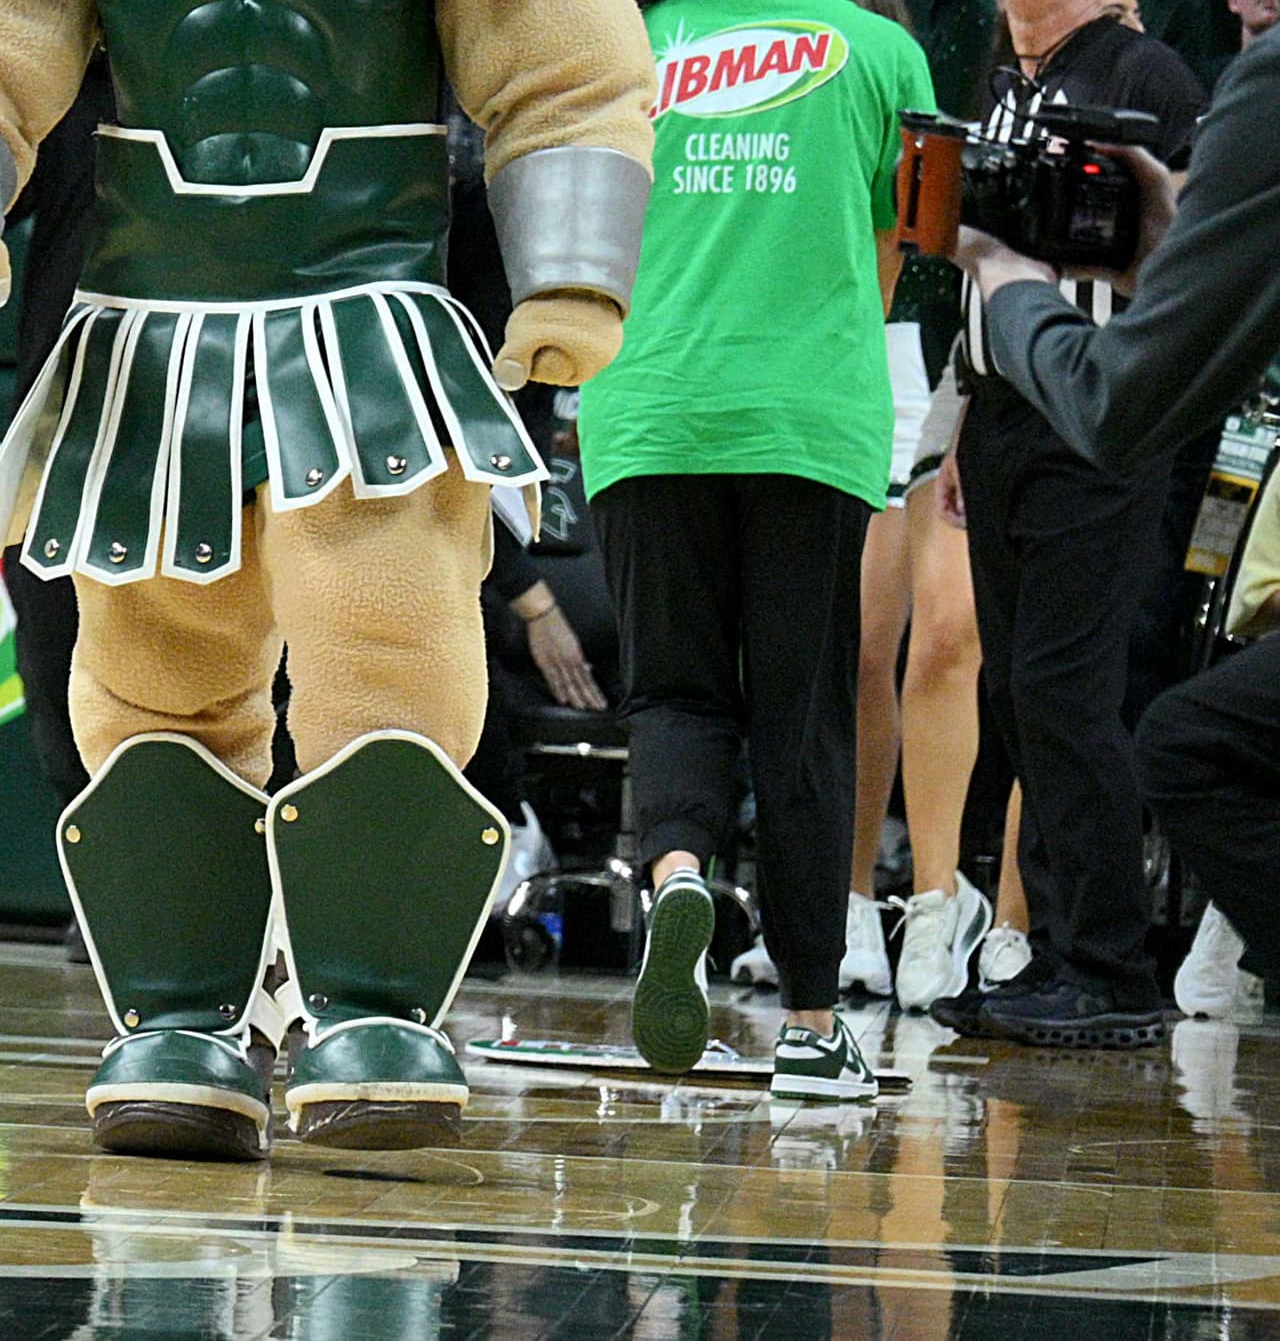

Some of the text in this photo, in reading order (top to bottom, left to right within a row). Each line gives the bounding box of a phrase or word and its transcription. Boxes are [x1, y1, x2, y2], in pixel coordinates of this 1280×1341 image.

[648, 34, 830, 119] IBMAN
[685, 132, 790, 161] CLEANING
[673, 164, 797, 194] SINCE 1896
